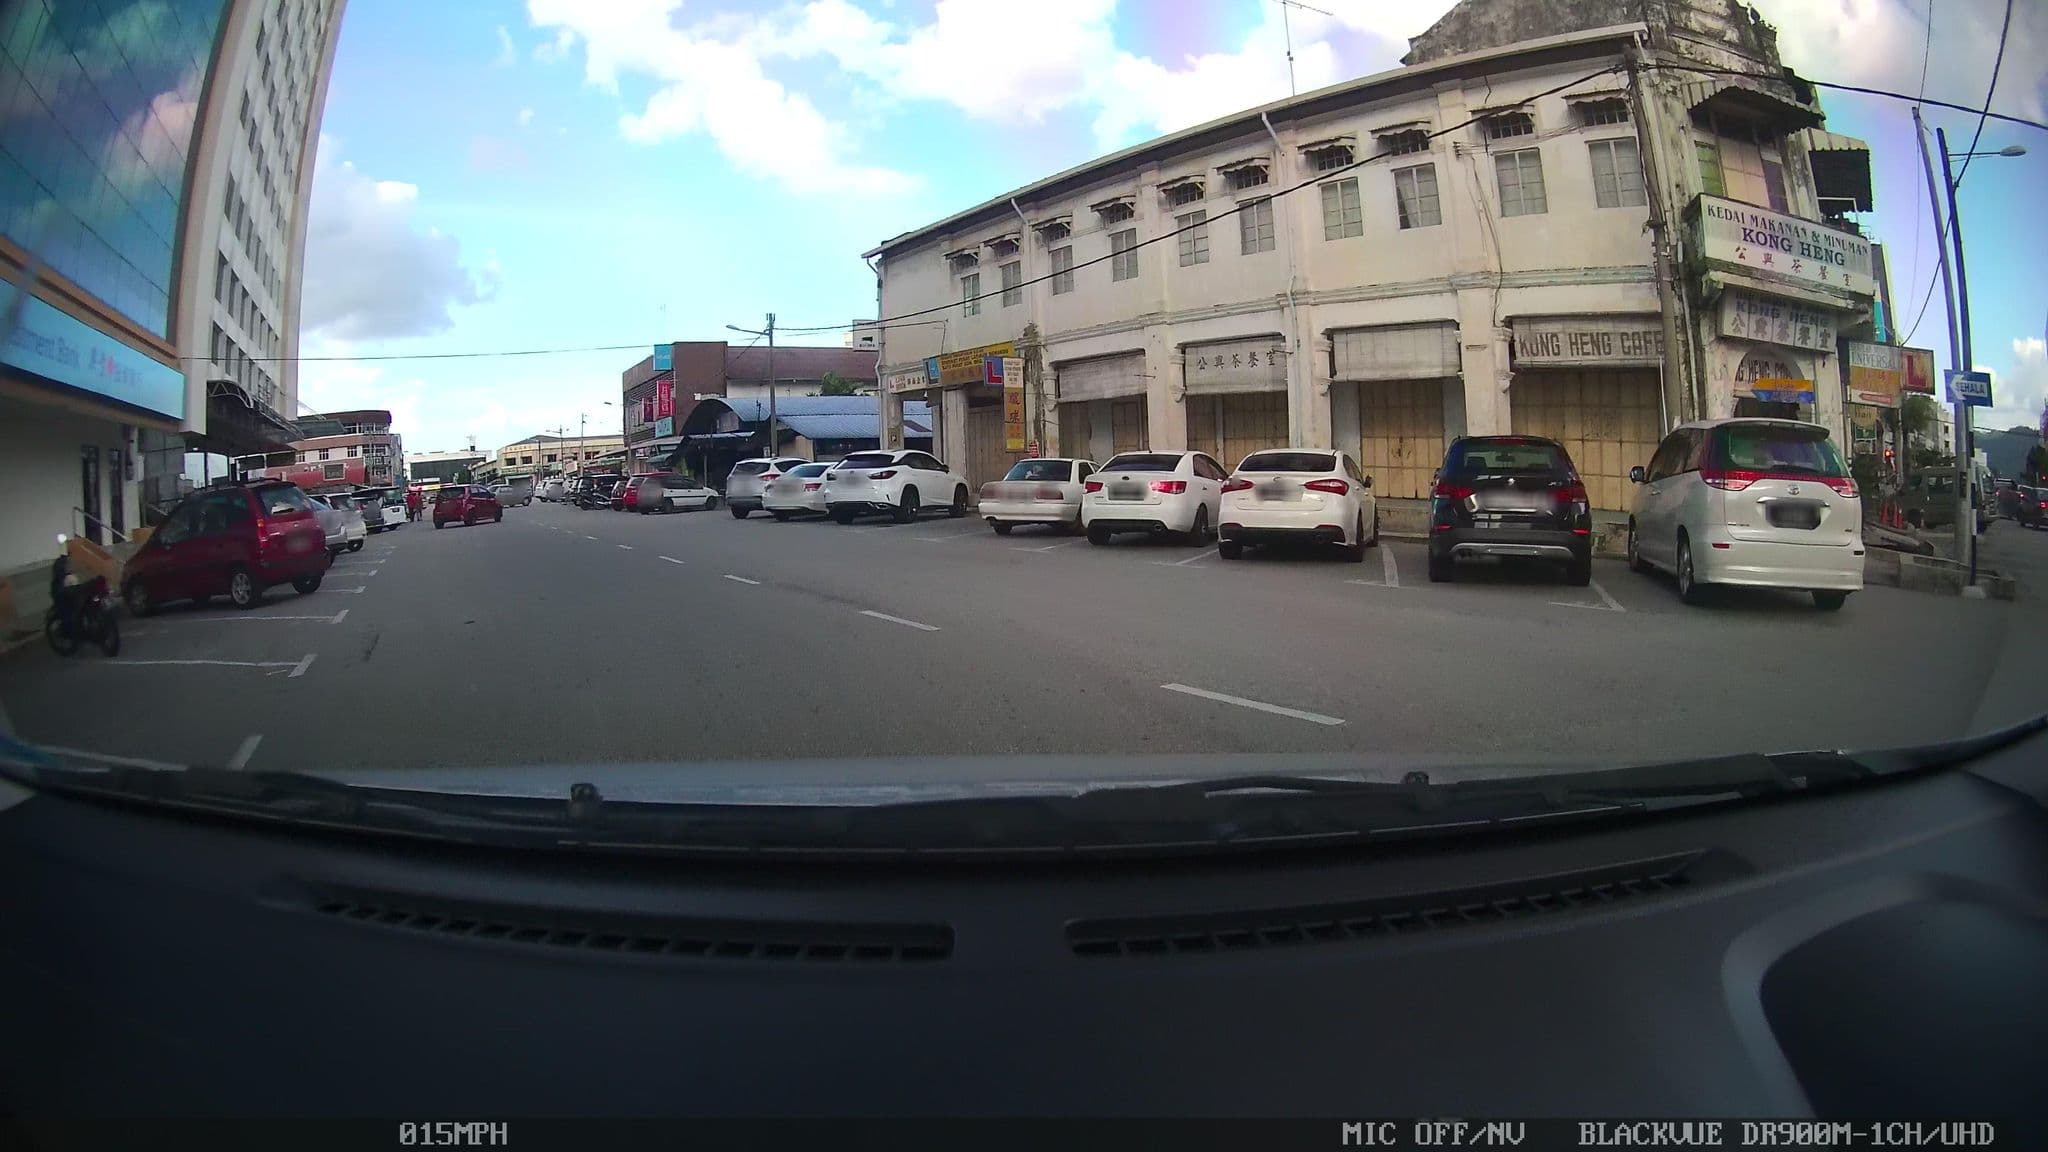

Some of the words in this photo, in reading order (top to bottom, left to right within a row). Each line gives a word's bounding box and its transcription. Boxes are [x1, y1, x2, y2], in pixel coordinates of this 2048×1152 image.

[1707, 204, 1745, 224] KEDAI
[1750, 214, 1807, 239] MAKANAN
[1811, 230, 1820, 242] &
[1824, 233, 1868, 256] MINUMAN
[1741, 227, 1793, 252] KONG
[1799, 241, 1845, 266] HENG
[1569, 331, 1611, 356] HENG
[1956, 381, 1985, 394] SEHALA
